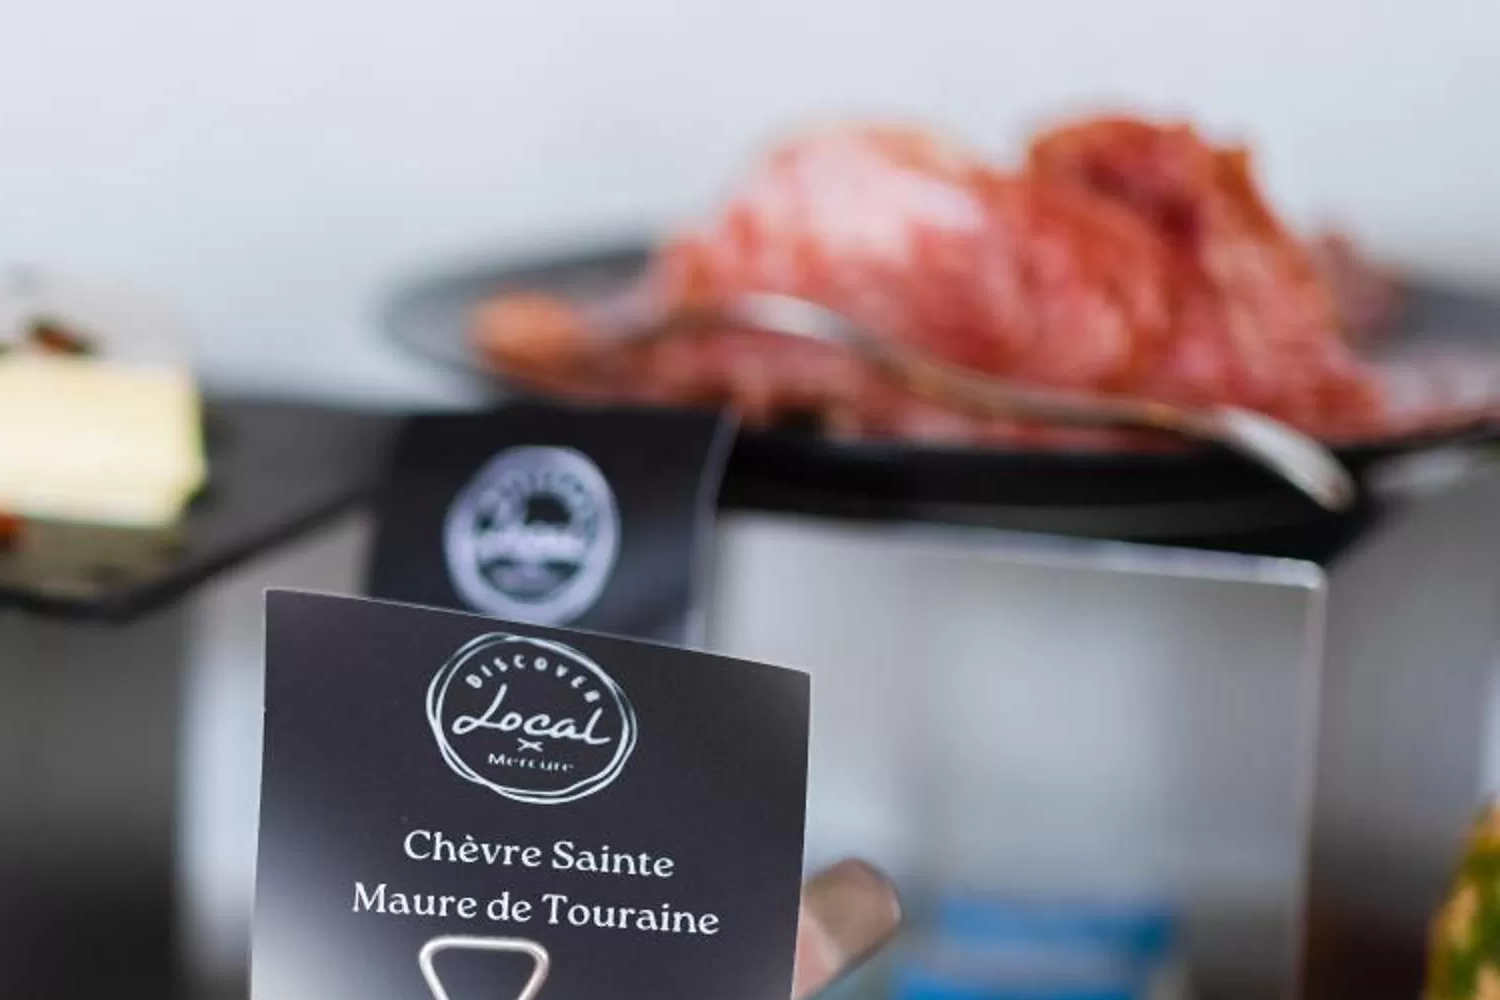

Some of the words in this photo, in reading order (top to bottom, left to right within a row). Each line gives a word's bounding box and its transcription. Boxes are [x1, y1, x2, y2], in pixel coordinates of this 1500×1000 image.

[464, 652, 602, 704] DISCOVER
[452, 682, 612, 746] Local
[487, 751, 575, 773] Mercure
[403, 829, 543, 868] Chèvre
[551, 840, 675, 878] Sainte
[351, 881, 478, 921] Maure
[486, 890, 533, 923] de
[542, 893, 721, 935] Touraine
